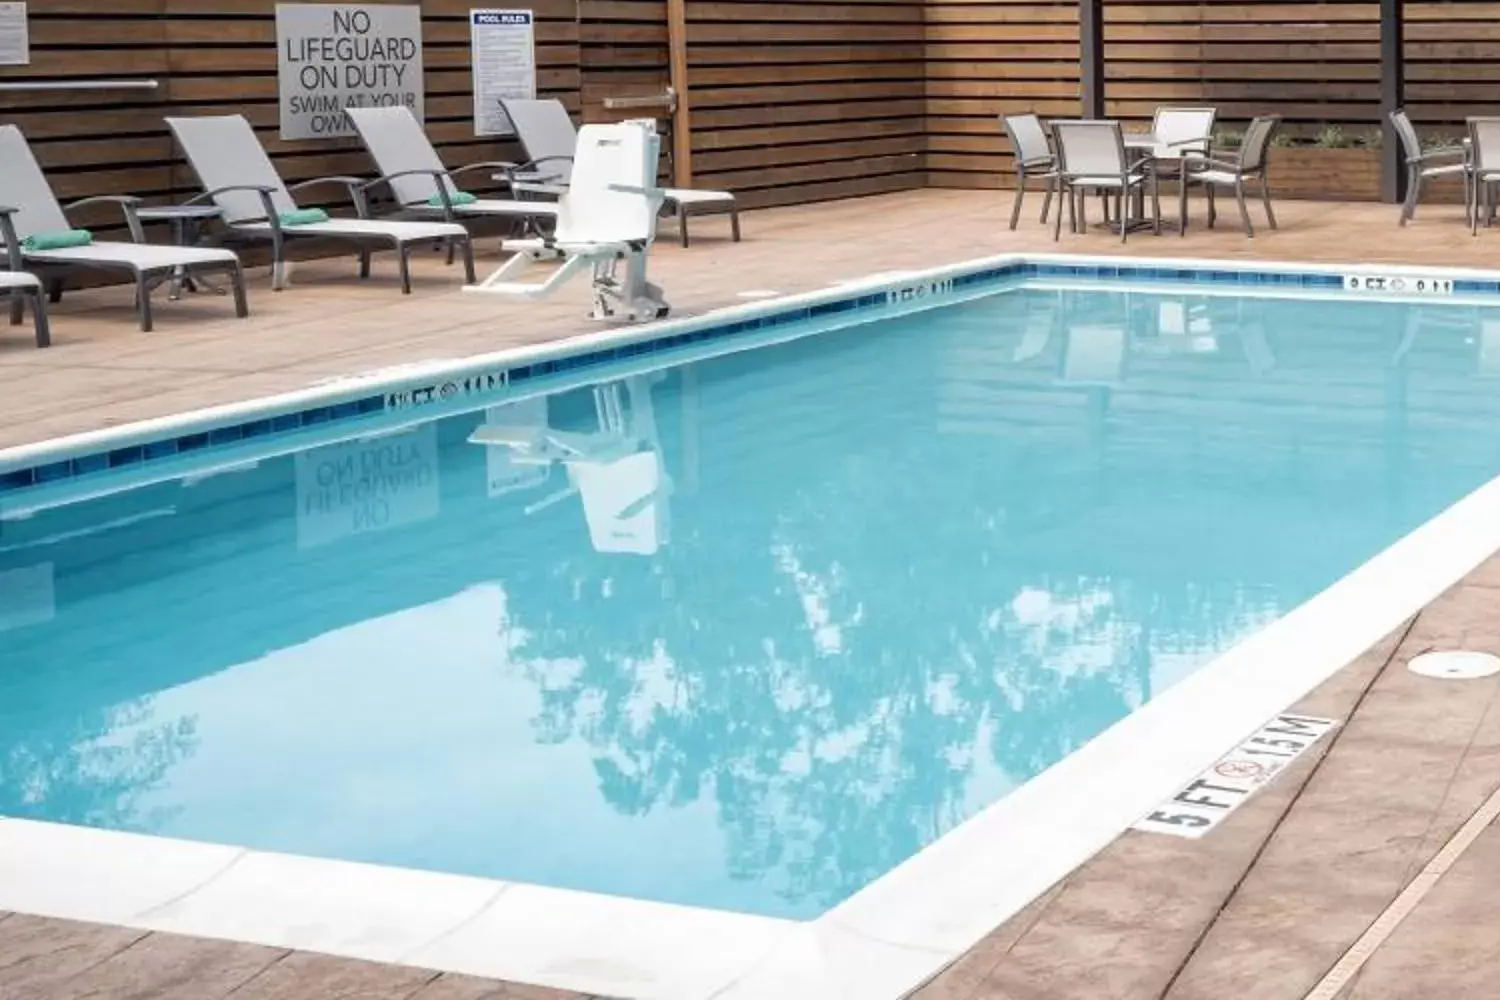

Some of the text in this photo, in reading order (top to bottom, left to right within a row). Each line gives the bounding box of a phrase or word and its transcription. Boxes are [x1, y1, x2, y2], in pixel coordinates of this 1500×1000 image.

[333, 10, 371, 34] NO
[287, 37, 416, 61] LIFEGUARD
[300, 63, 406, 90] ON DUTY
[289, 92, 416, 115] SWIM AT YOUR
